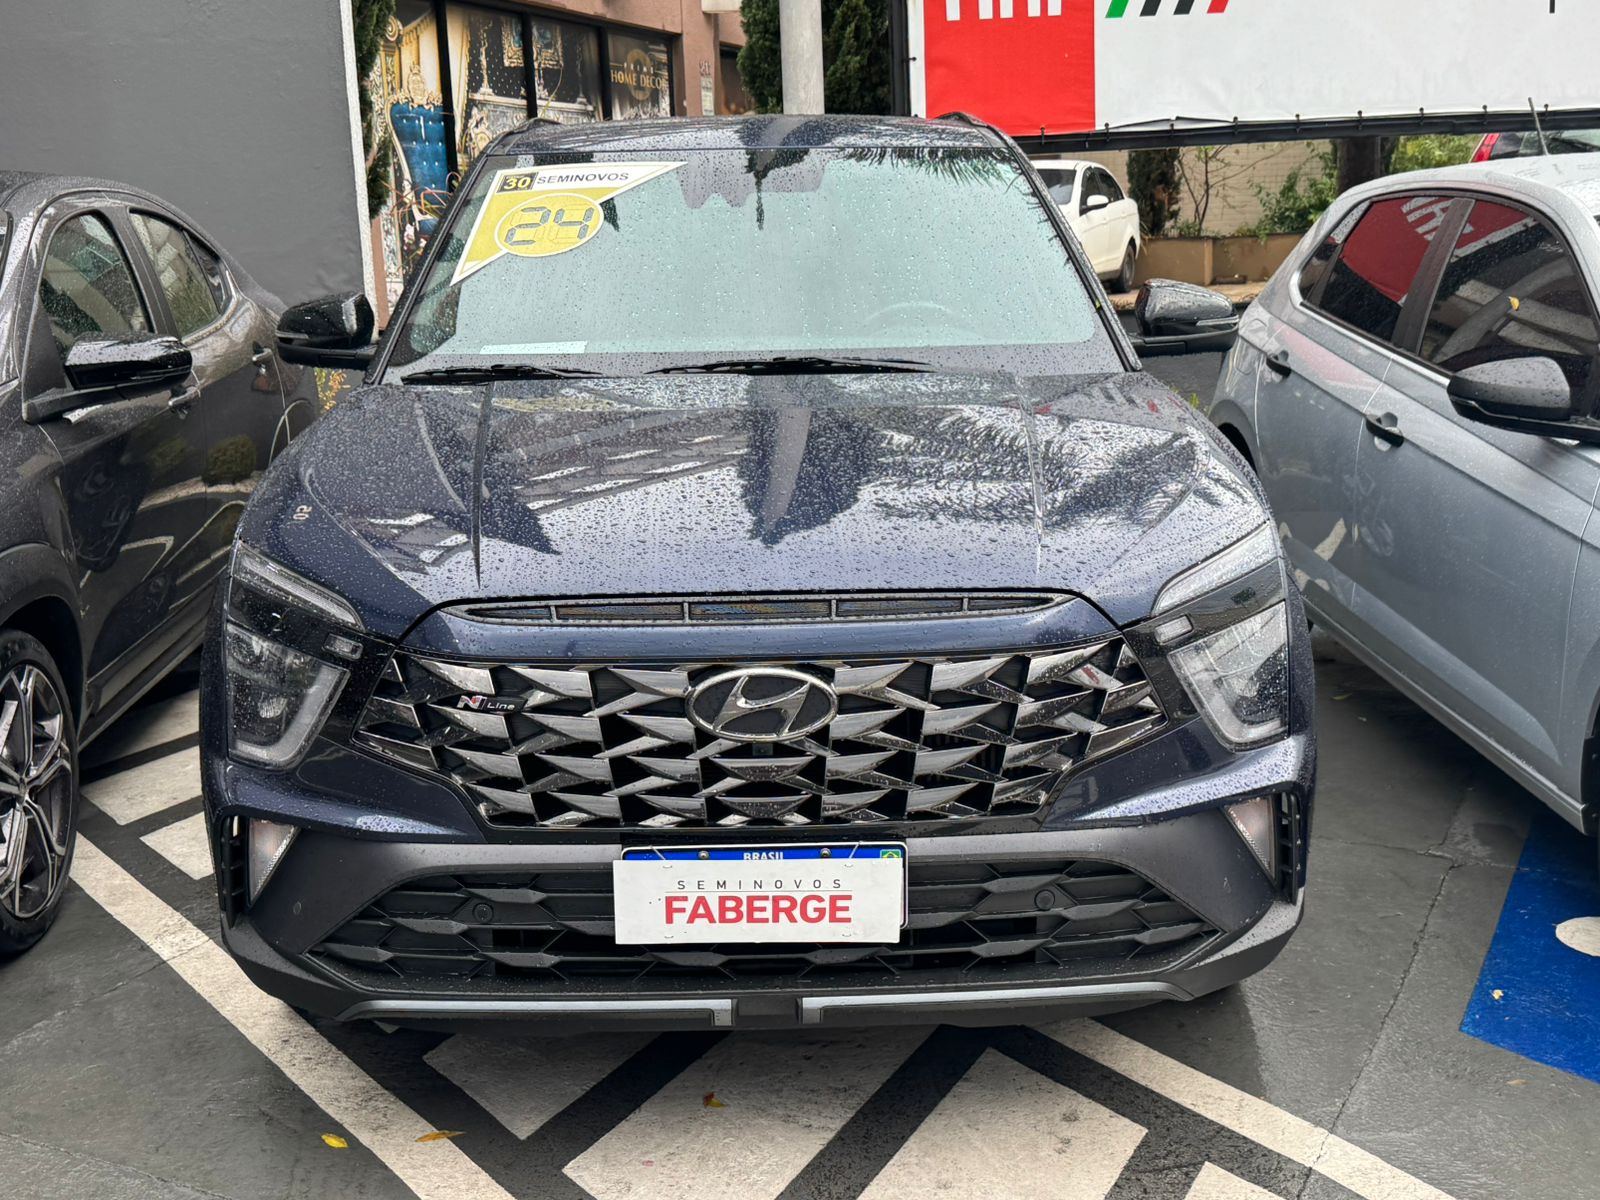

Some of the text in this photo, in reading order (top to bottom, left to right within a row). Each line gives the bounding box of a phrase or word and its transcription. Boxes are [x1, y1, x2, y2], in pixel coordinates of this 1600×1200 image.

[610, 70, 637, 86] HOME
[503, 172, 629, 190] 30 SEMINOVOS
[504, 206, 594, 246] 24
[487, 702, 515, 710] Line
[677, 878, 841, 890] SEMINOVOS
[664, 894, 853, 924] FABERGE
